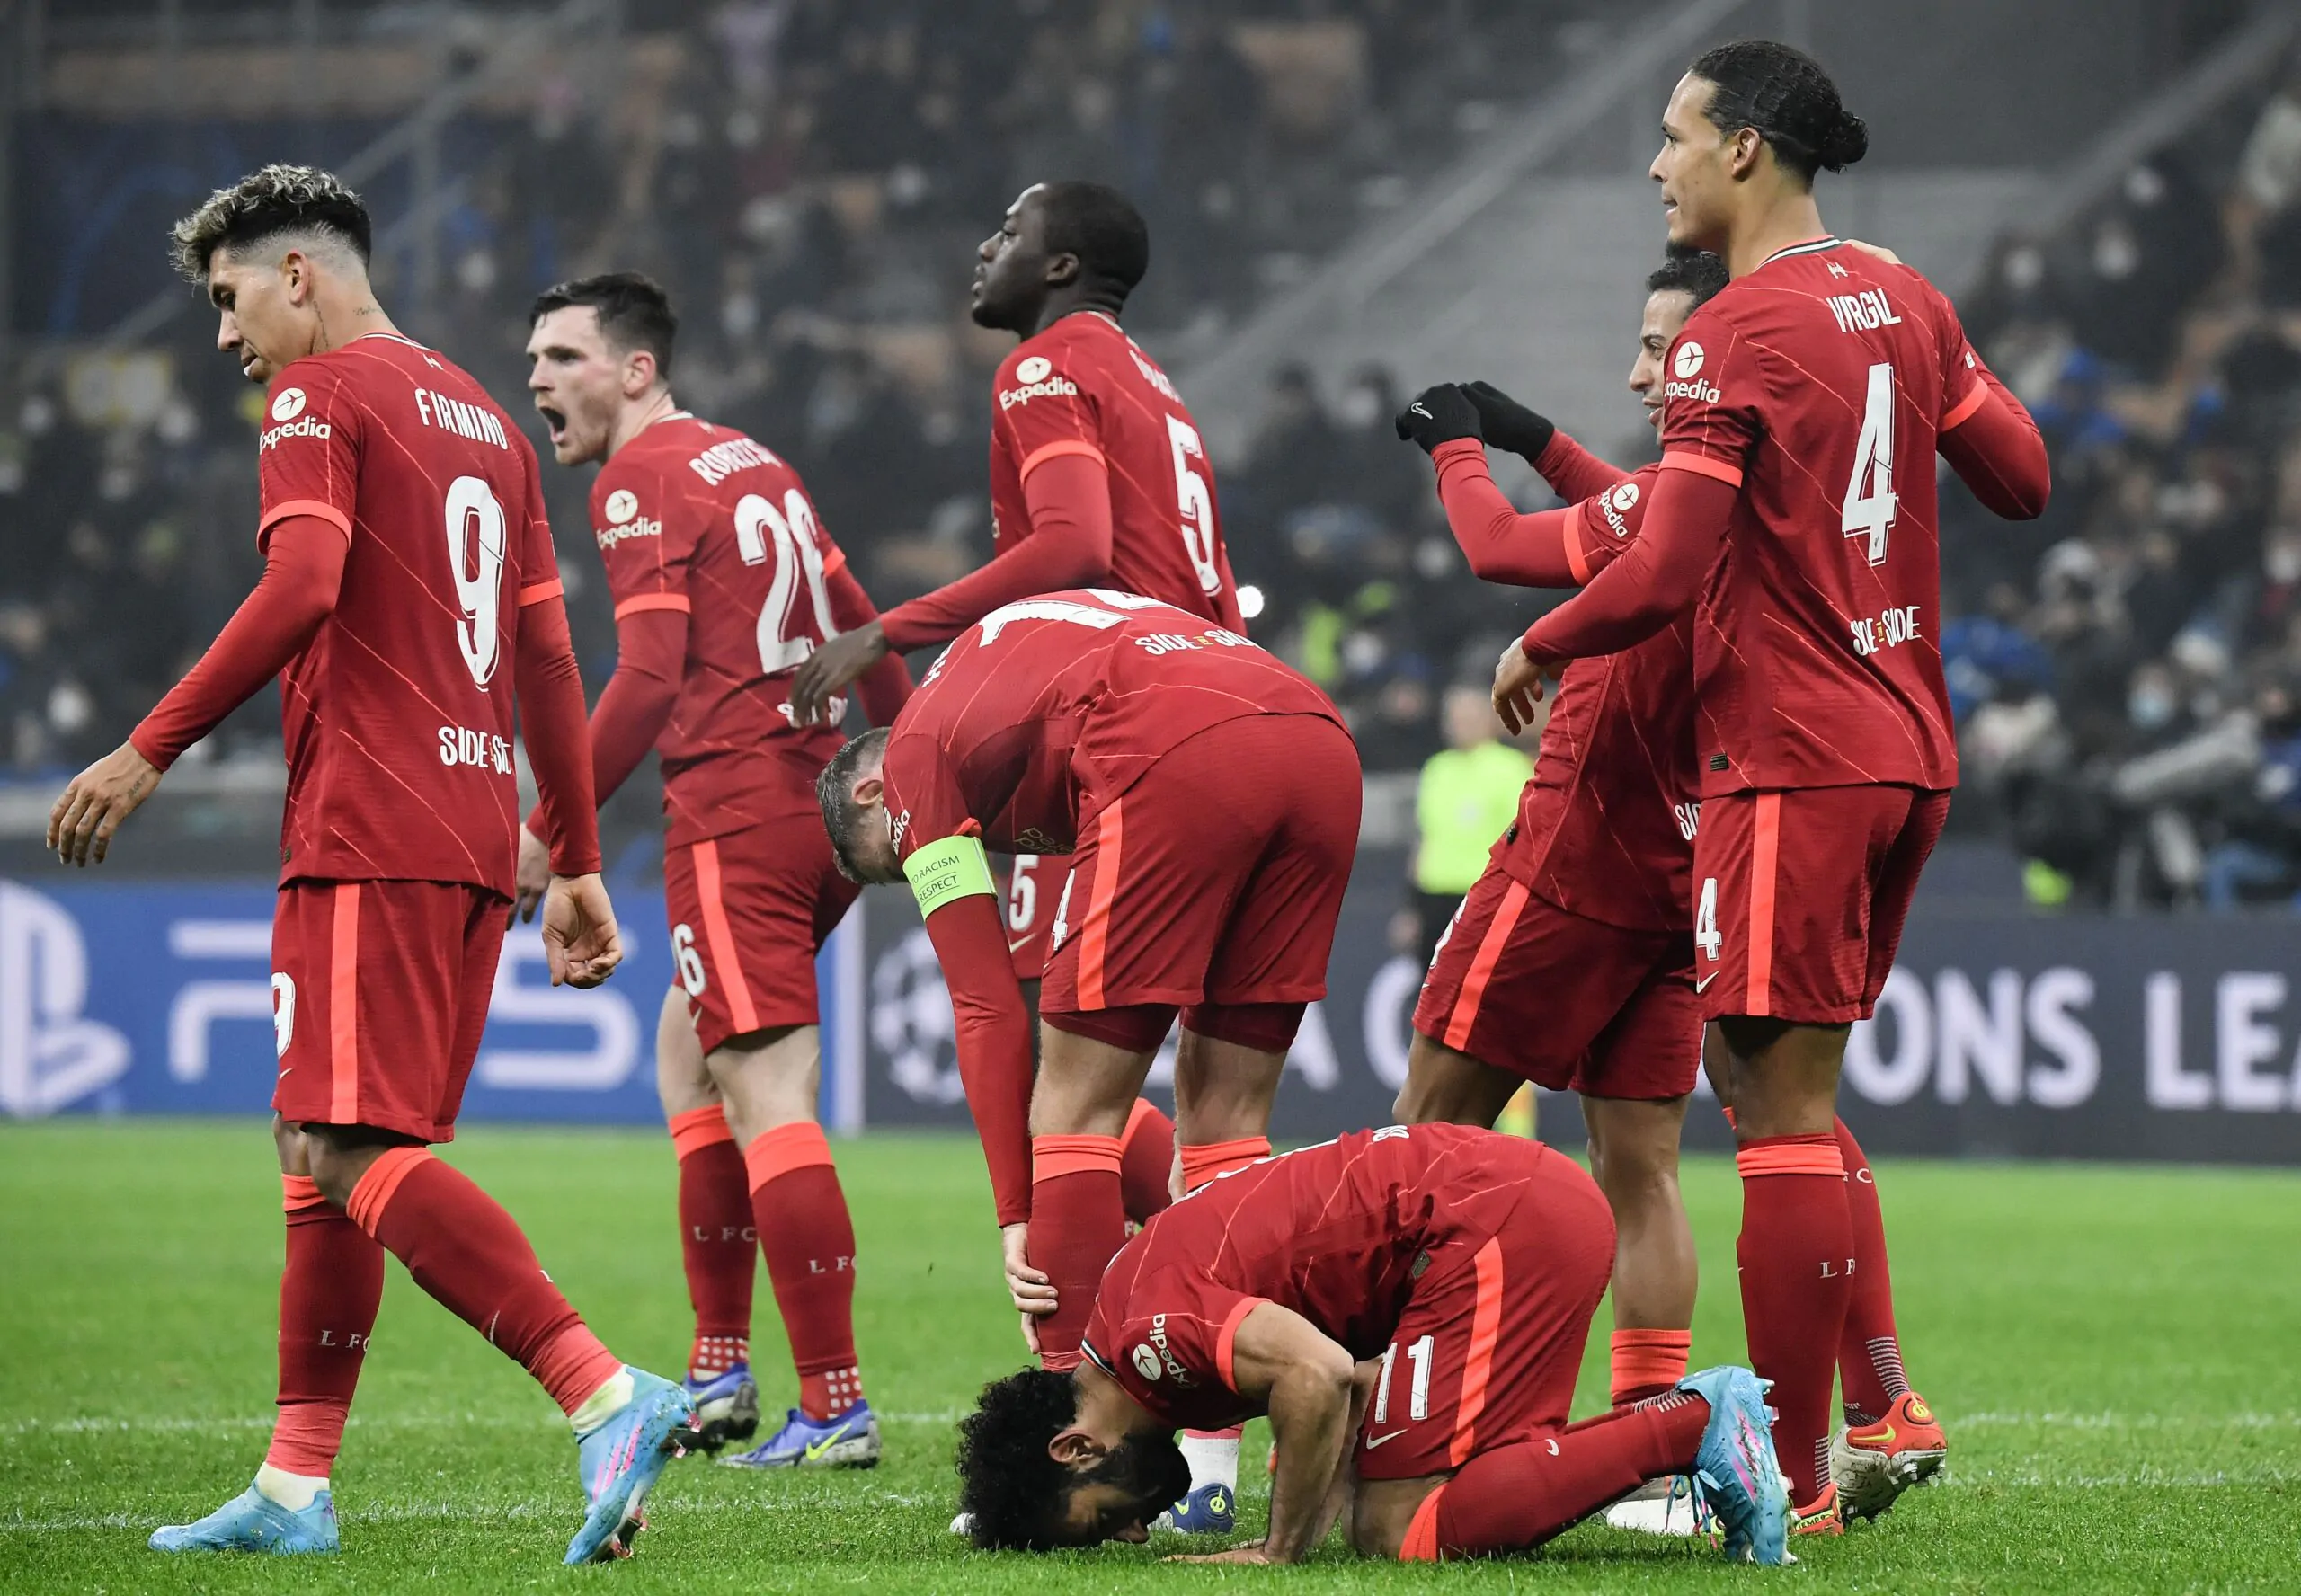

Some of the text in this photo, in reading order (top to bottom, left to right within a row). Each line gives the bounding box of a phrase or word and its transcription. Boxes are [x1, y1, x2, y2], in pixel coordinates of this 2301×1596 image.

[1825, 288, 1902, 332] VIRGIL
[414, 387, 509, 450] FIRMINO
[999, 375, 1079, 412] Expedia
[1842, 362, 1899, 568] 4
[1166, 412, 1222, 597] 5
[444, 475, 506, 693] 9
[1134, 634, 1203, 655] SIDE
[1881, 606, 1922, 648] SIDE
[438, 726, 488, 768] SIDE
[919, 855, 960, 879] RACISM
[919, 874, 958, 902] RESPECT
[1008, 853, 1040, 933] 5
[1695, 877, 1723, 962] 4
[670, 922, 707, 998] 6
[1374, 1335, 1435, 1423] 11
